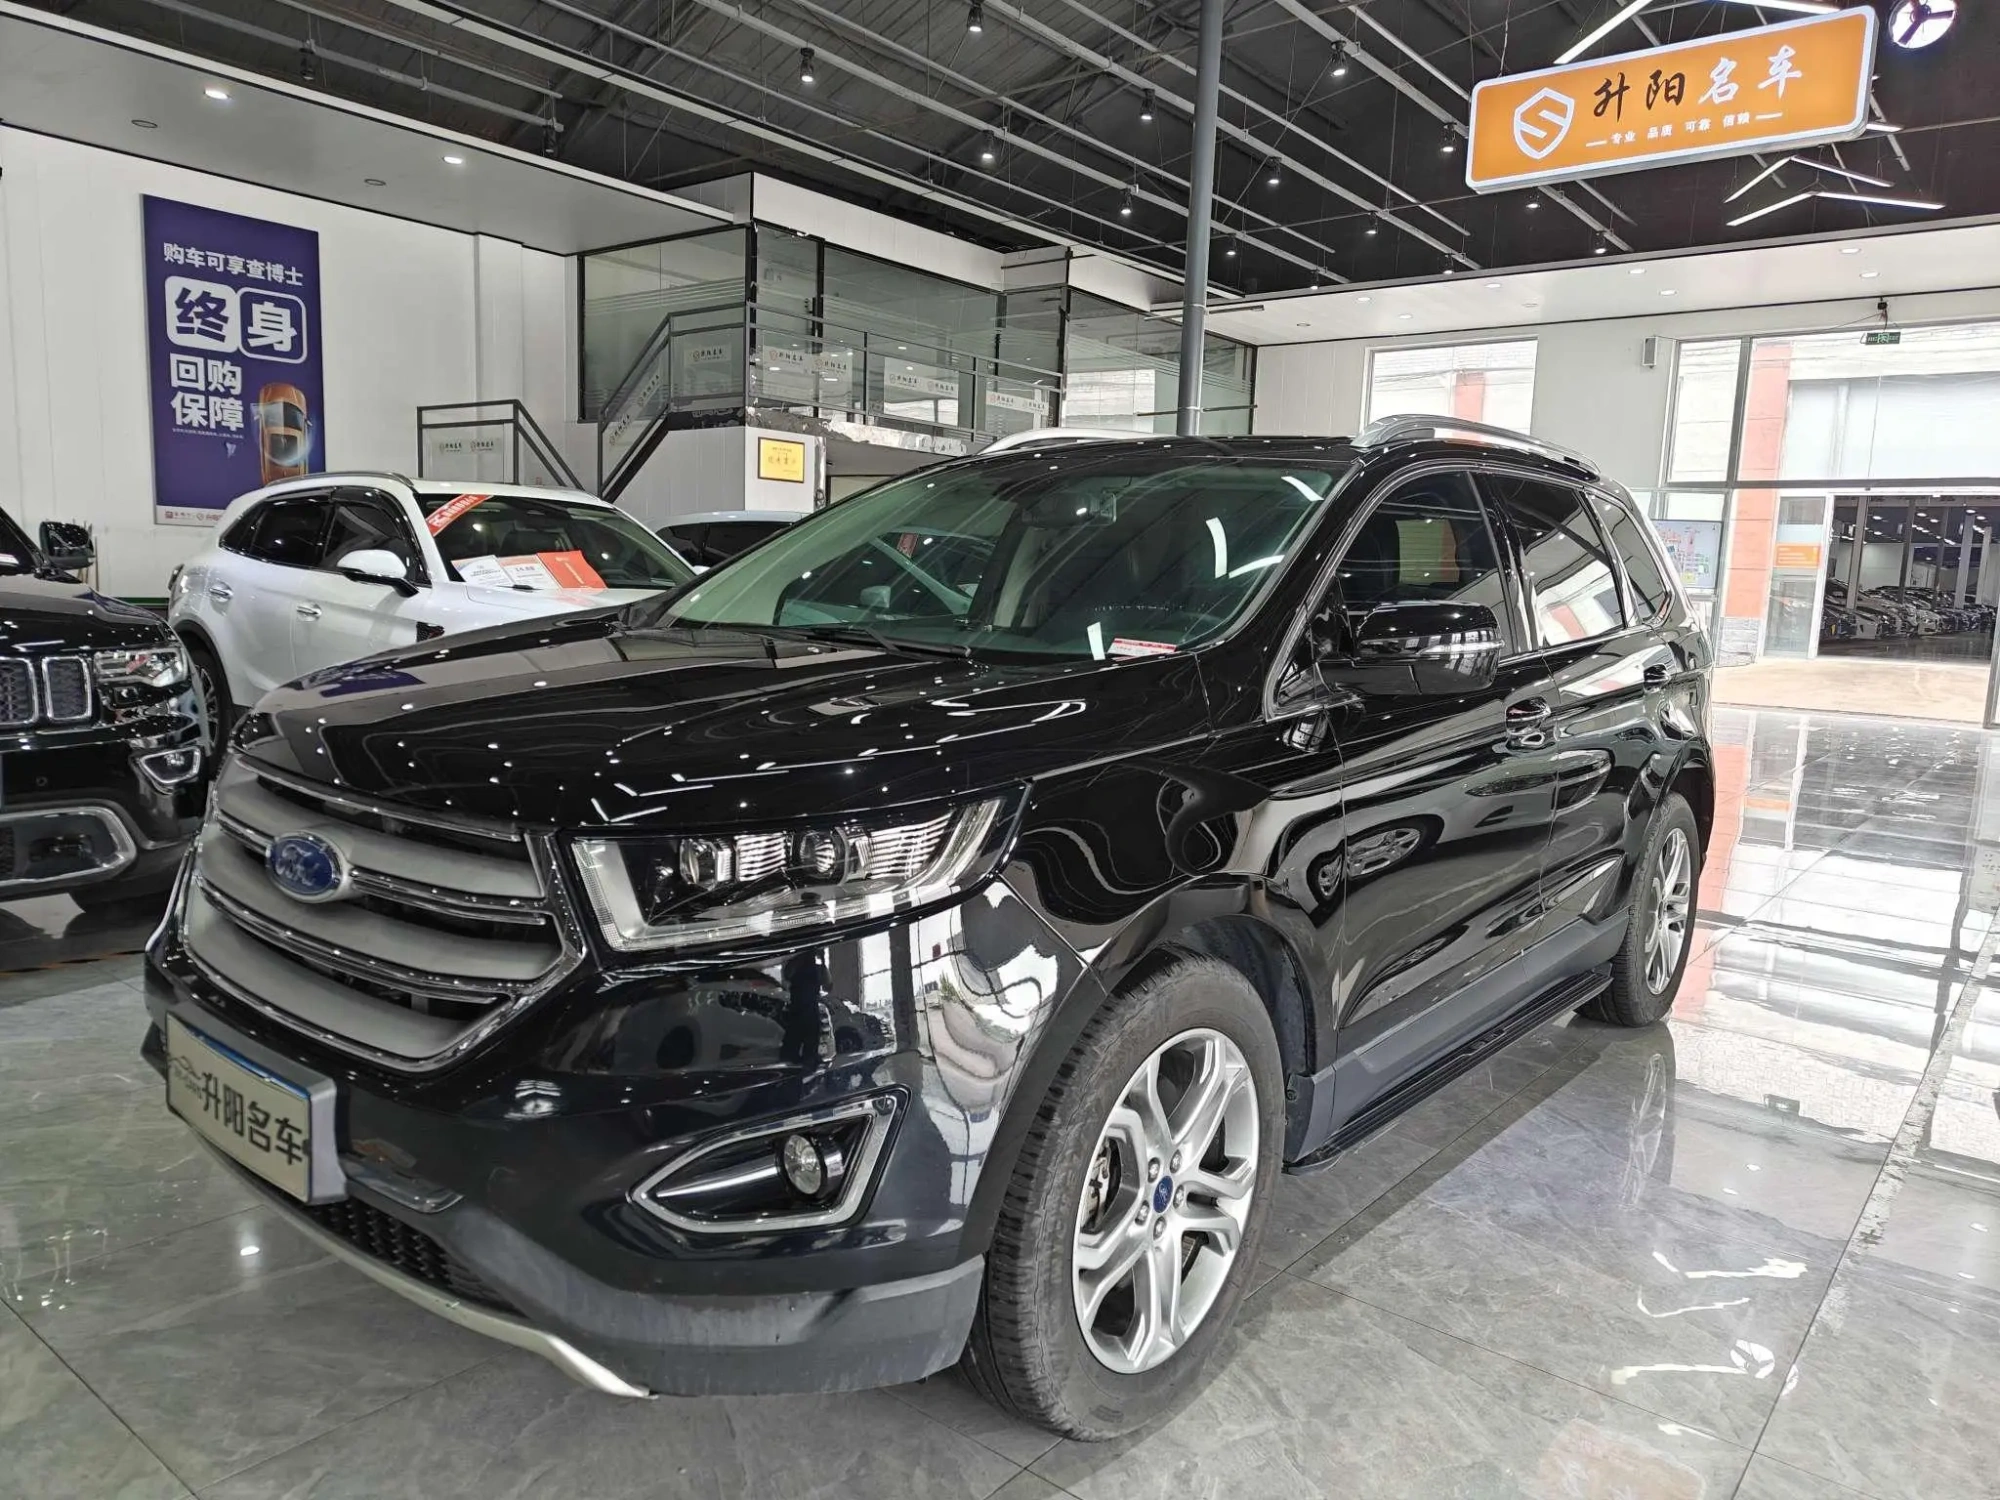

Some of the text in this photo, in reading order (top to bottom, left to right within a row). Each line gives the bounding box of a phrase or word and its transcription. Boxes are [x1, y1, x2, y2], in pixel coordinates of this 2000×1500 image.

[1593, 45, 1803, 122] 升阳名车
[1610, 112, 1750, 145] 专业 品质 可靠 信赖
[163, 242, 304, 287] 购车可享查博士
[174, 287, 298, 352] 终身
[169, 352, 242, 395] 回购
[170, 391, 244, 432] 保障
[201, 1071, 303, 1166] 升阳名车
